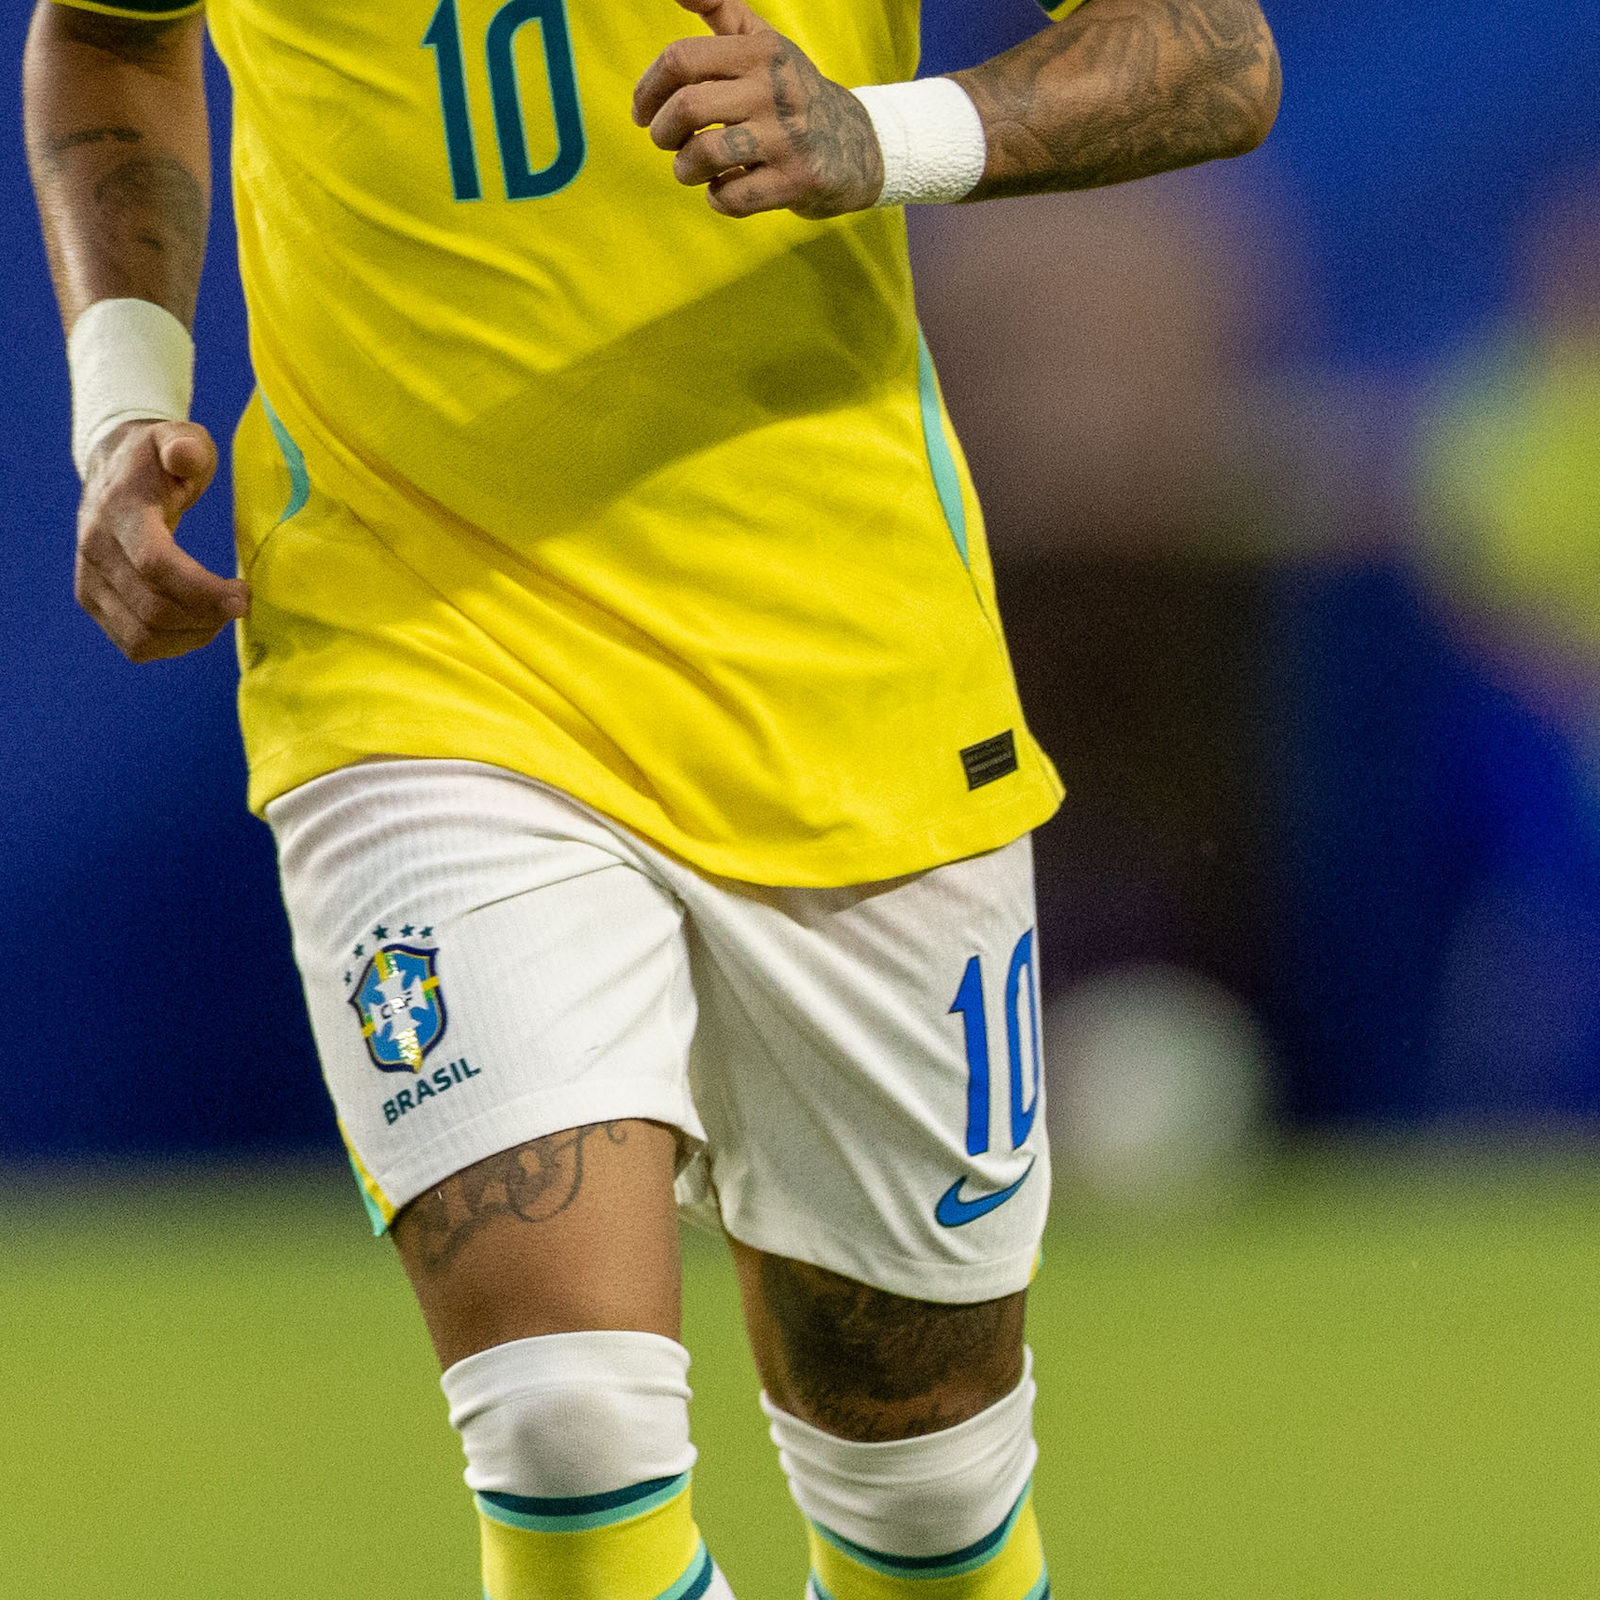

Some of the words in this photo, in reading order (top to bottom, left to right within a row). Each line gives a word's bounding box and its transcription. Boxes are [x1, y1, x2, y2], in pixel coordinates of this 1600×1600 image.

[380, 991, 412, 1019] CF
[948, 926, 1040, 1156] 10
[382, 1057, 482, 1126] BRASIL
